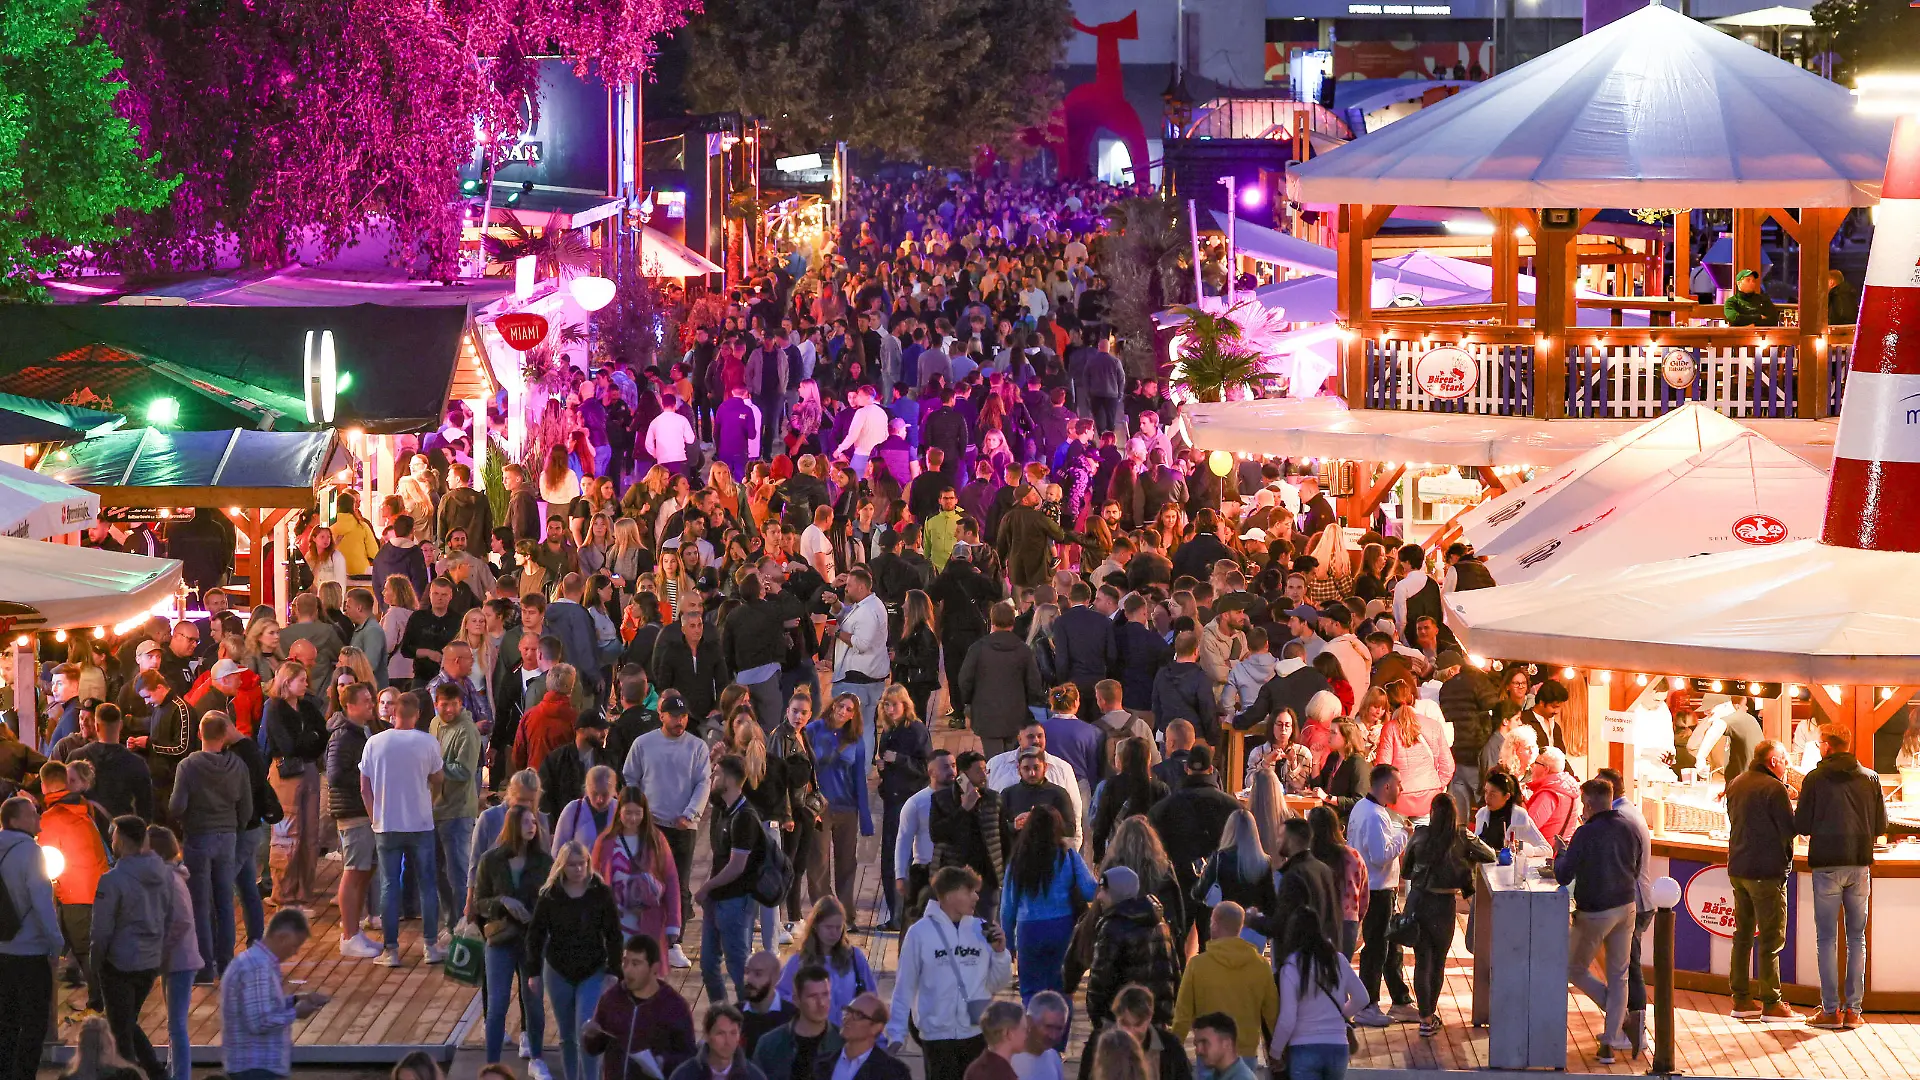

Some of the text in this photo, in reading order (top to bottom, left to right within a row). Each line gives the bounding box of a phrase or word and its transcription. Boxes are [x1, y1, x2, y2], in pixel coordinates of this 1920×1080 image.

[510, 325, 540, 341] MIAMI
[1439, 383, 1465, 392] Stark
[452, 943, 471, 967] D
